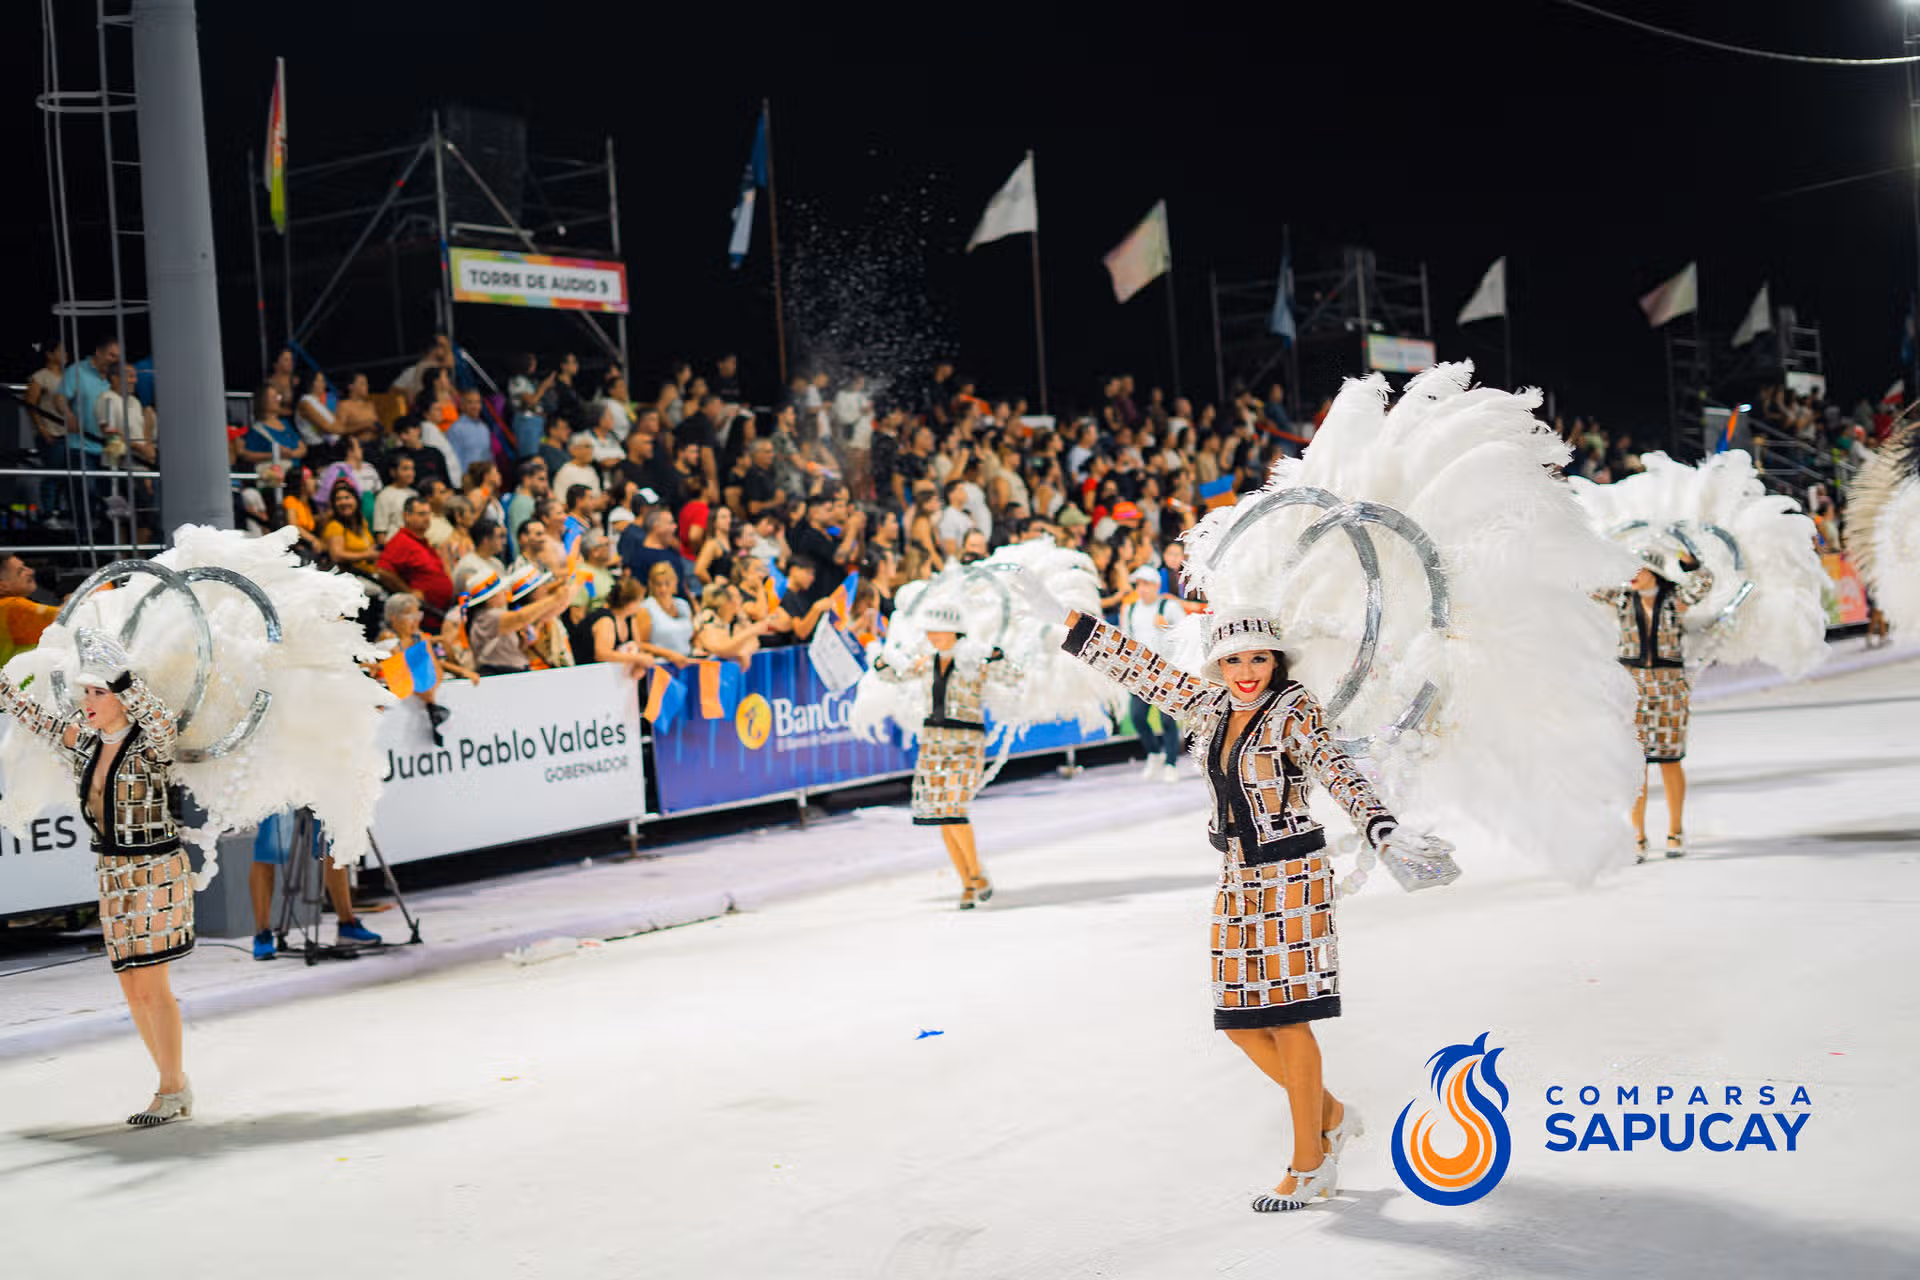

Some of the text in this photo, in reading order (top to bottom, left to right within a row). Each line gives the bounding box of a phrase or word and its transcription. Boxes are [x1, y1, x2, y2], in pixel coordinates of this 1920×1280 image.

[469, 269, 522, 288] TORRE
[527, 274, 546, 289] DE
[551, 277, 596, 294] AUDIO
[382, 713, 626, 783] Juan Pablo Valdés
[0, 815, 77, 856] ES
